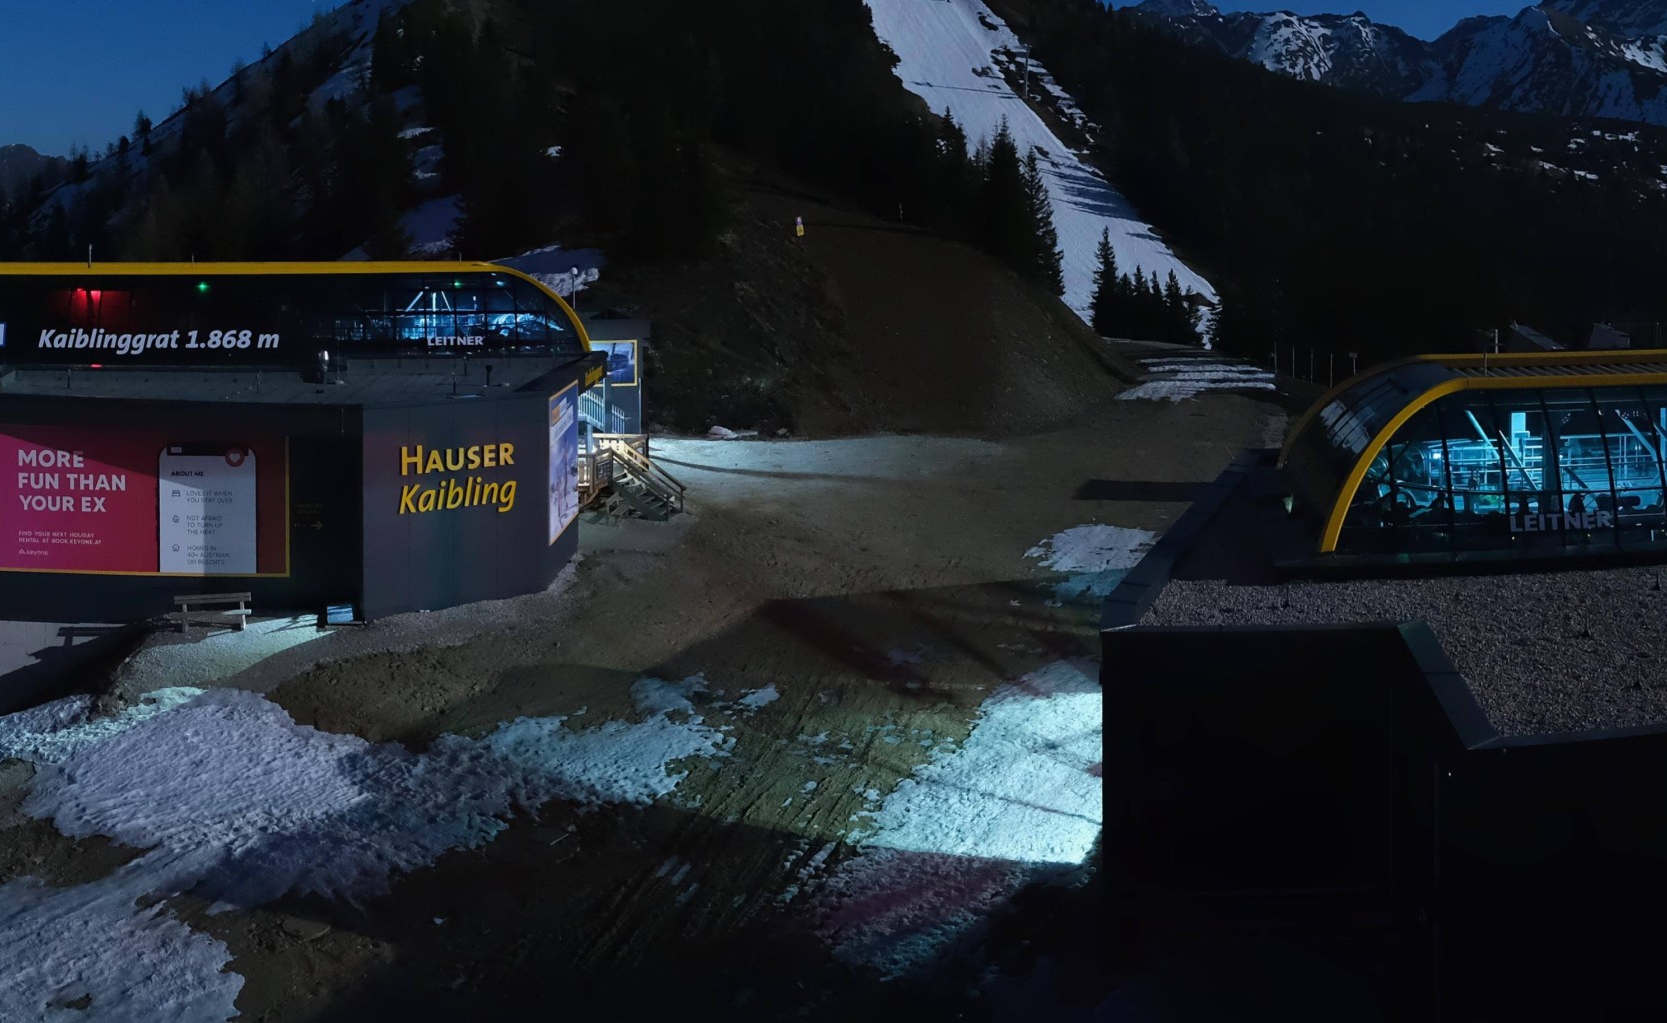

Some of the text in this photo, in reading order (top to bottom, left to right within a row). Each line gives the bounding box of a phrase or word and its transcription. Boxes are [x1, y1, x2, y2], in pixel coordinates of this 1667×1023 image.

[38, 328, 280, 355] Kaiblinggrat 1.868 m
[427, 335, 484, 346] LEITNER
[18, 449, 85, 468] MORE
[400, 443, 514, 476] HAUSER
[18, 473, 126, 491] FUN THAN
[19, 495, 107, 513] YOUR EX
[398, 477, 517, 514] Kaibling
[1510, 510, 1613, 533] LEITNER
